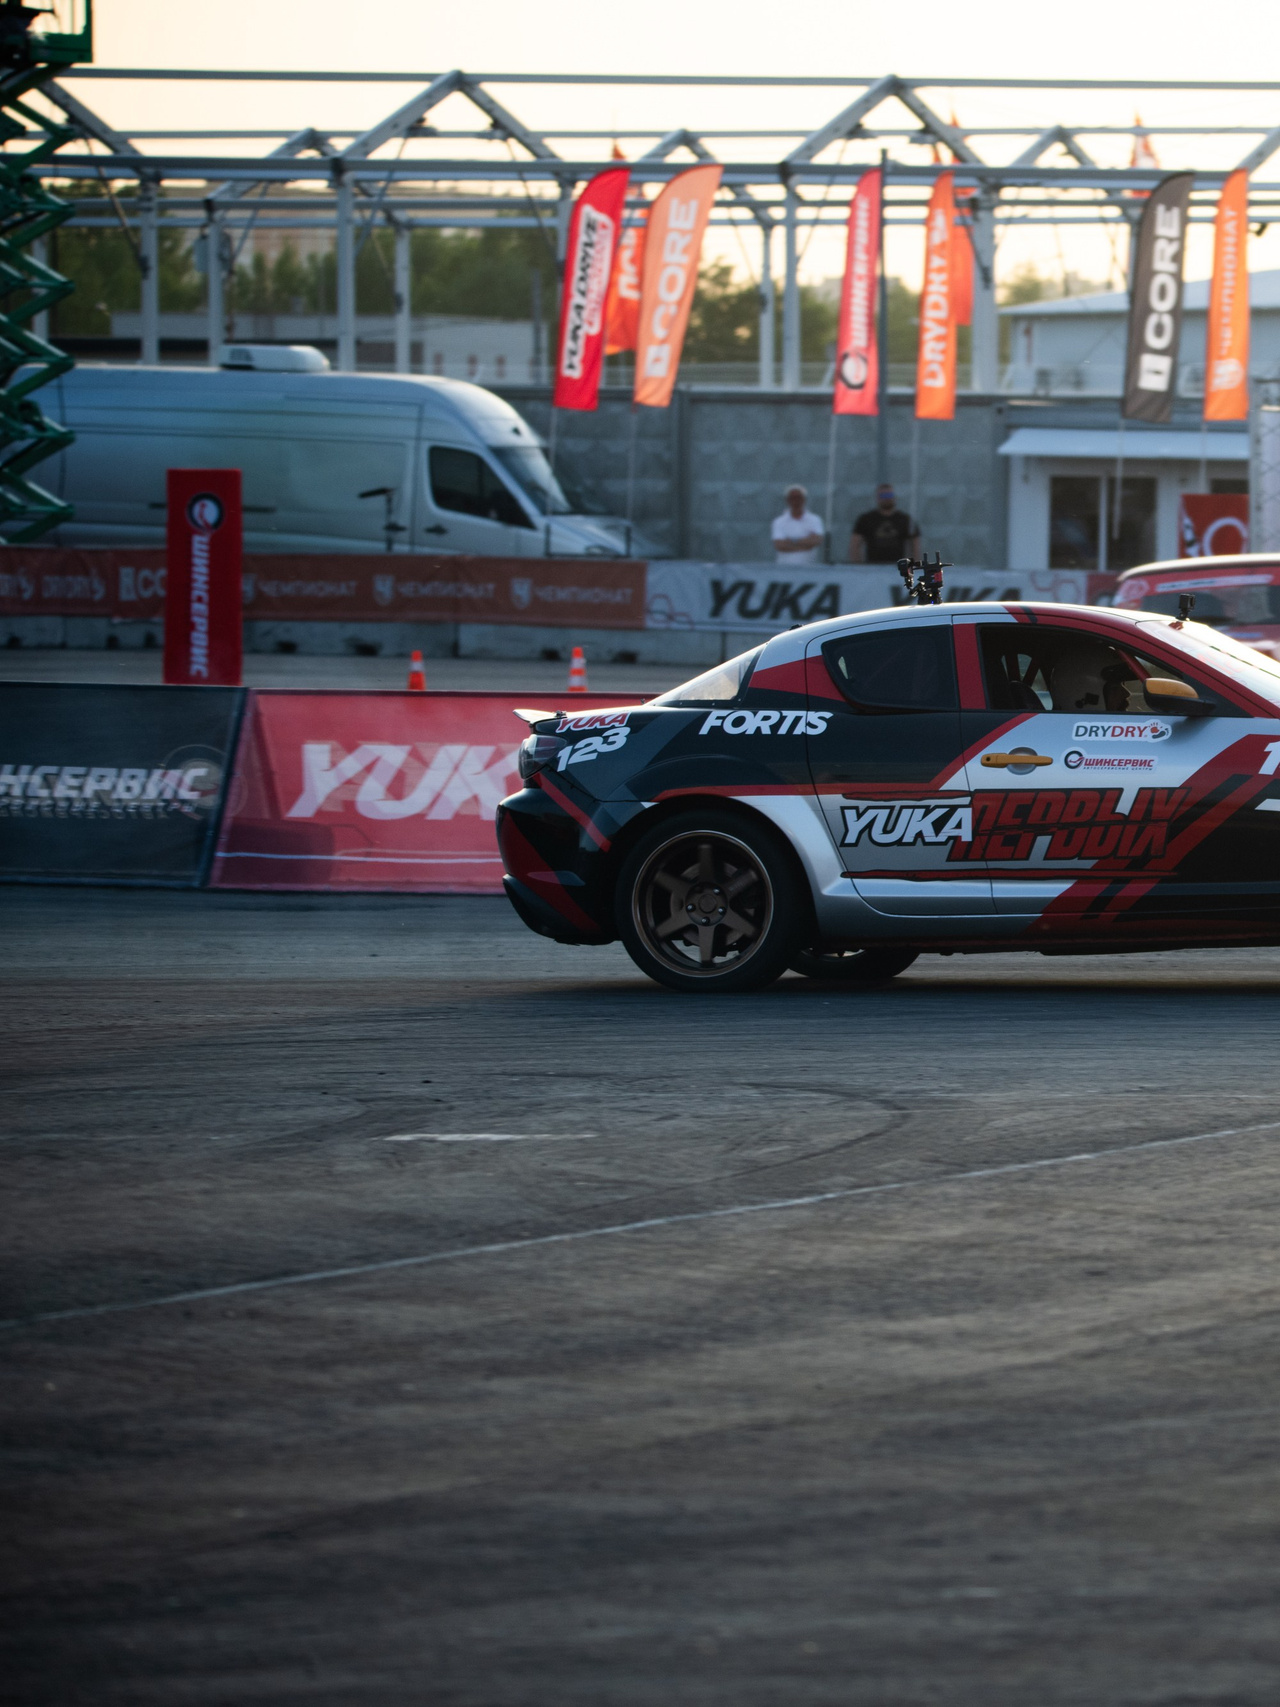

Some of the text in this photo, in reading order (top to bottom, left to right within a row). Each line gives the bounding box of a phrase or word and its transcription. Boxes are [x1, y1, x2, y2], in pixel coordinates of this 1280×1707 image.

[709, 580, 841, 619] YUKA
[556, 711, 632, 733] YUKA
[699, 710, 833, 735] FORTIS
[1075, 725, 1148, 738] DRYDRY
[557, 727, 631, 772] 123
[1083, 758, 1154, 768] ШИНСЕРВИС
[840, 806, 973, 846] YUKA
